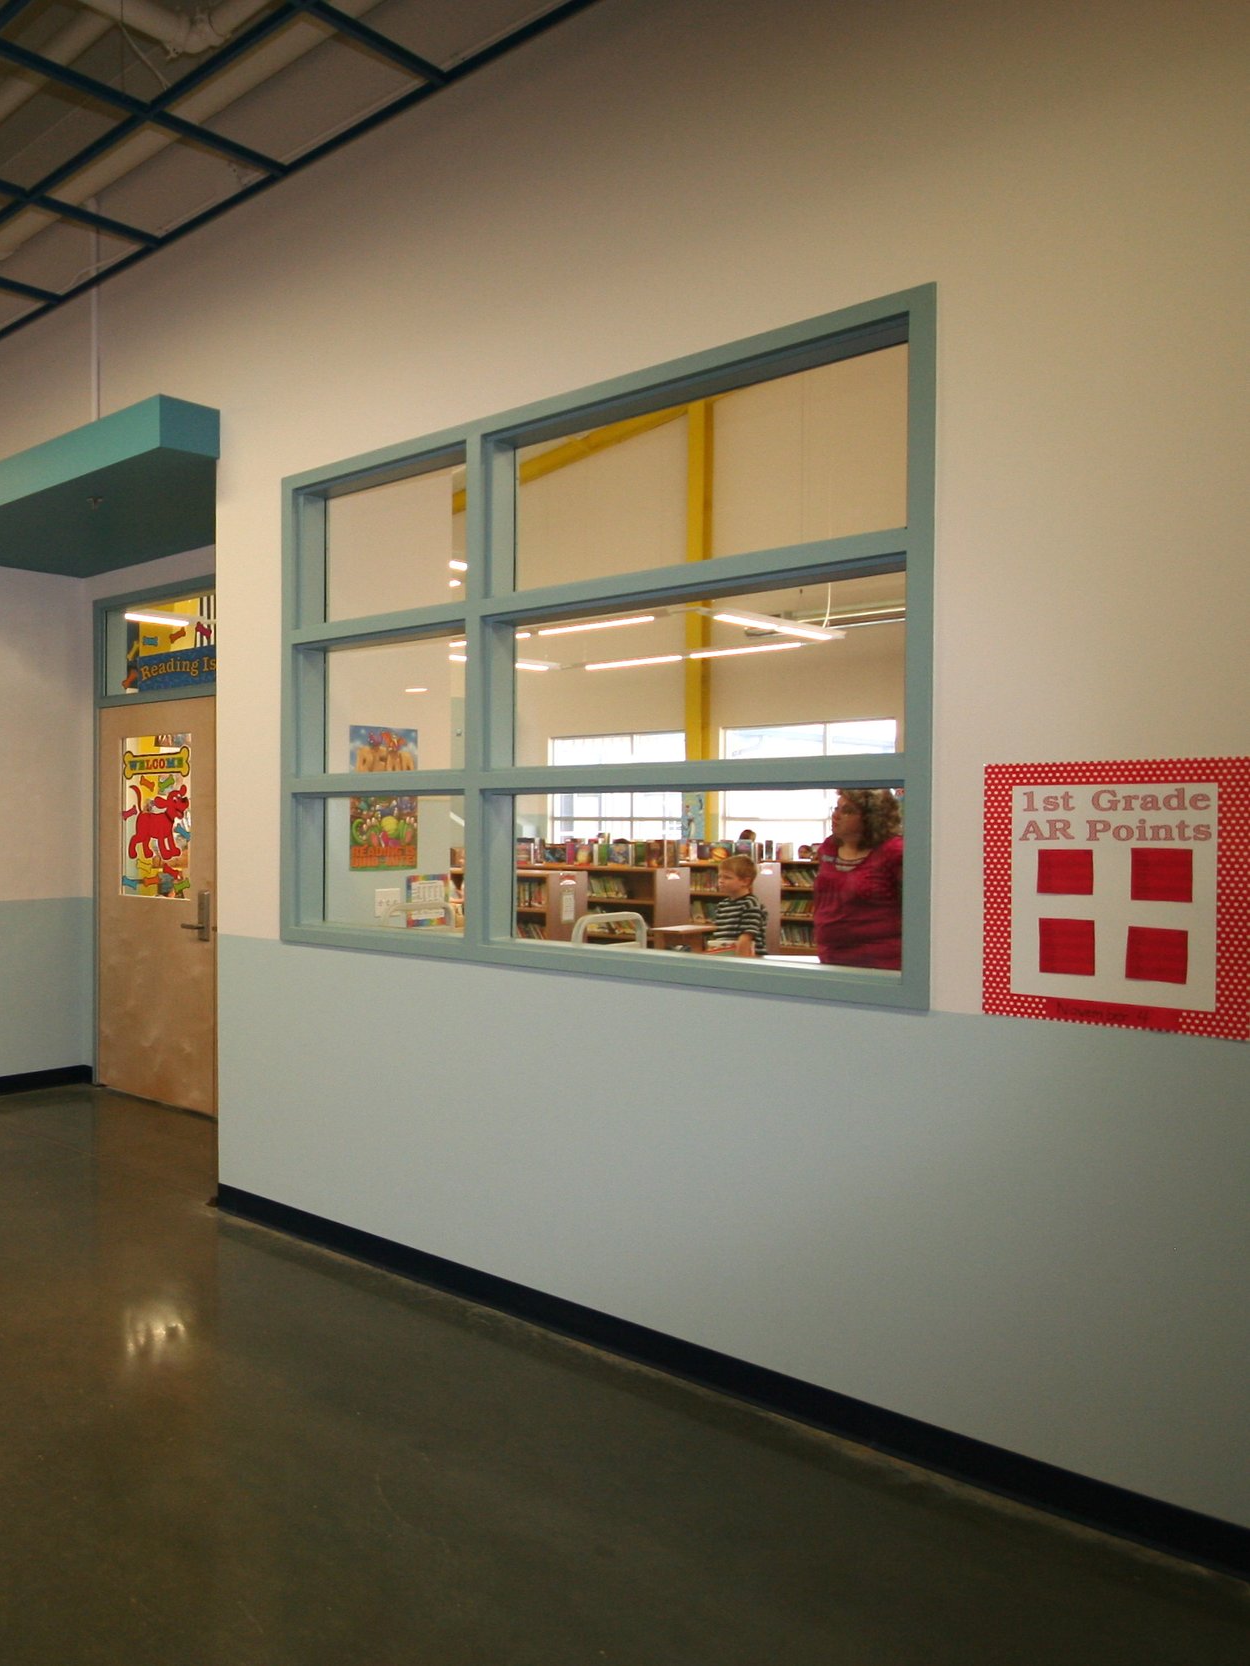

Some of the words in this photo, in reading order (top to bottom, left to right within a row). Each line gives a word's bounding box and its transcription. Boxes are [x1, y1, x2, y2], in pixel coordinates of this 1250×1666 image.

[141, 656, 199, 681] Reading
[203, 656, 216, 672] Is
[129, 757, 184, 771] WELCOME
[1022, 790, 1076, 812] 1st
[1091, 787, 1212, 812] Grade
[1018, 819, 1075, 841] AR
[1086, 818, 1213, 842] Points
